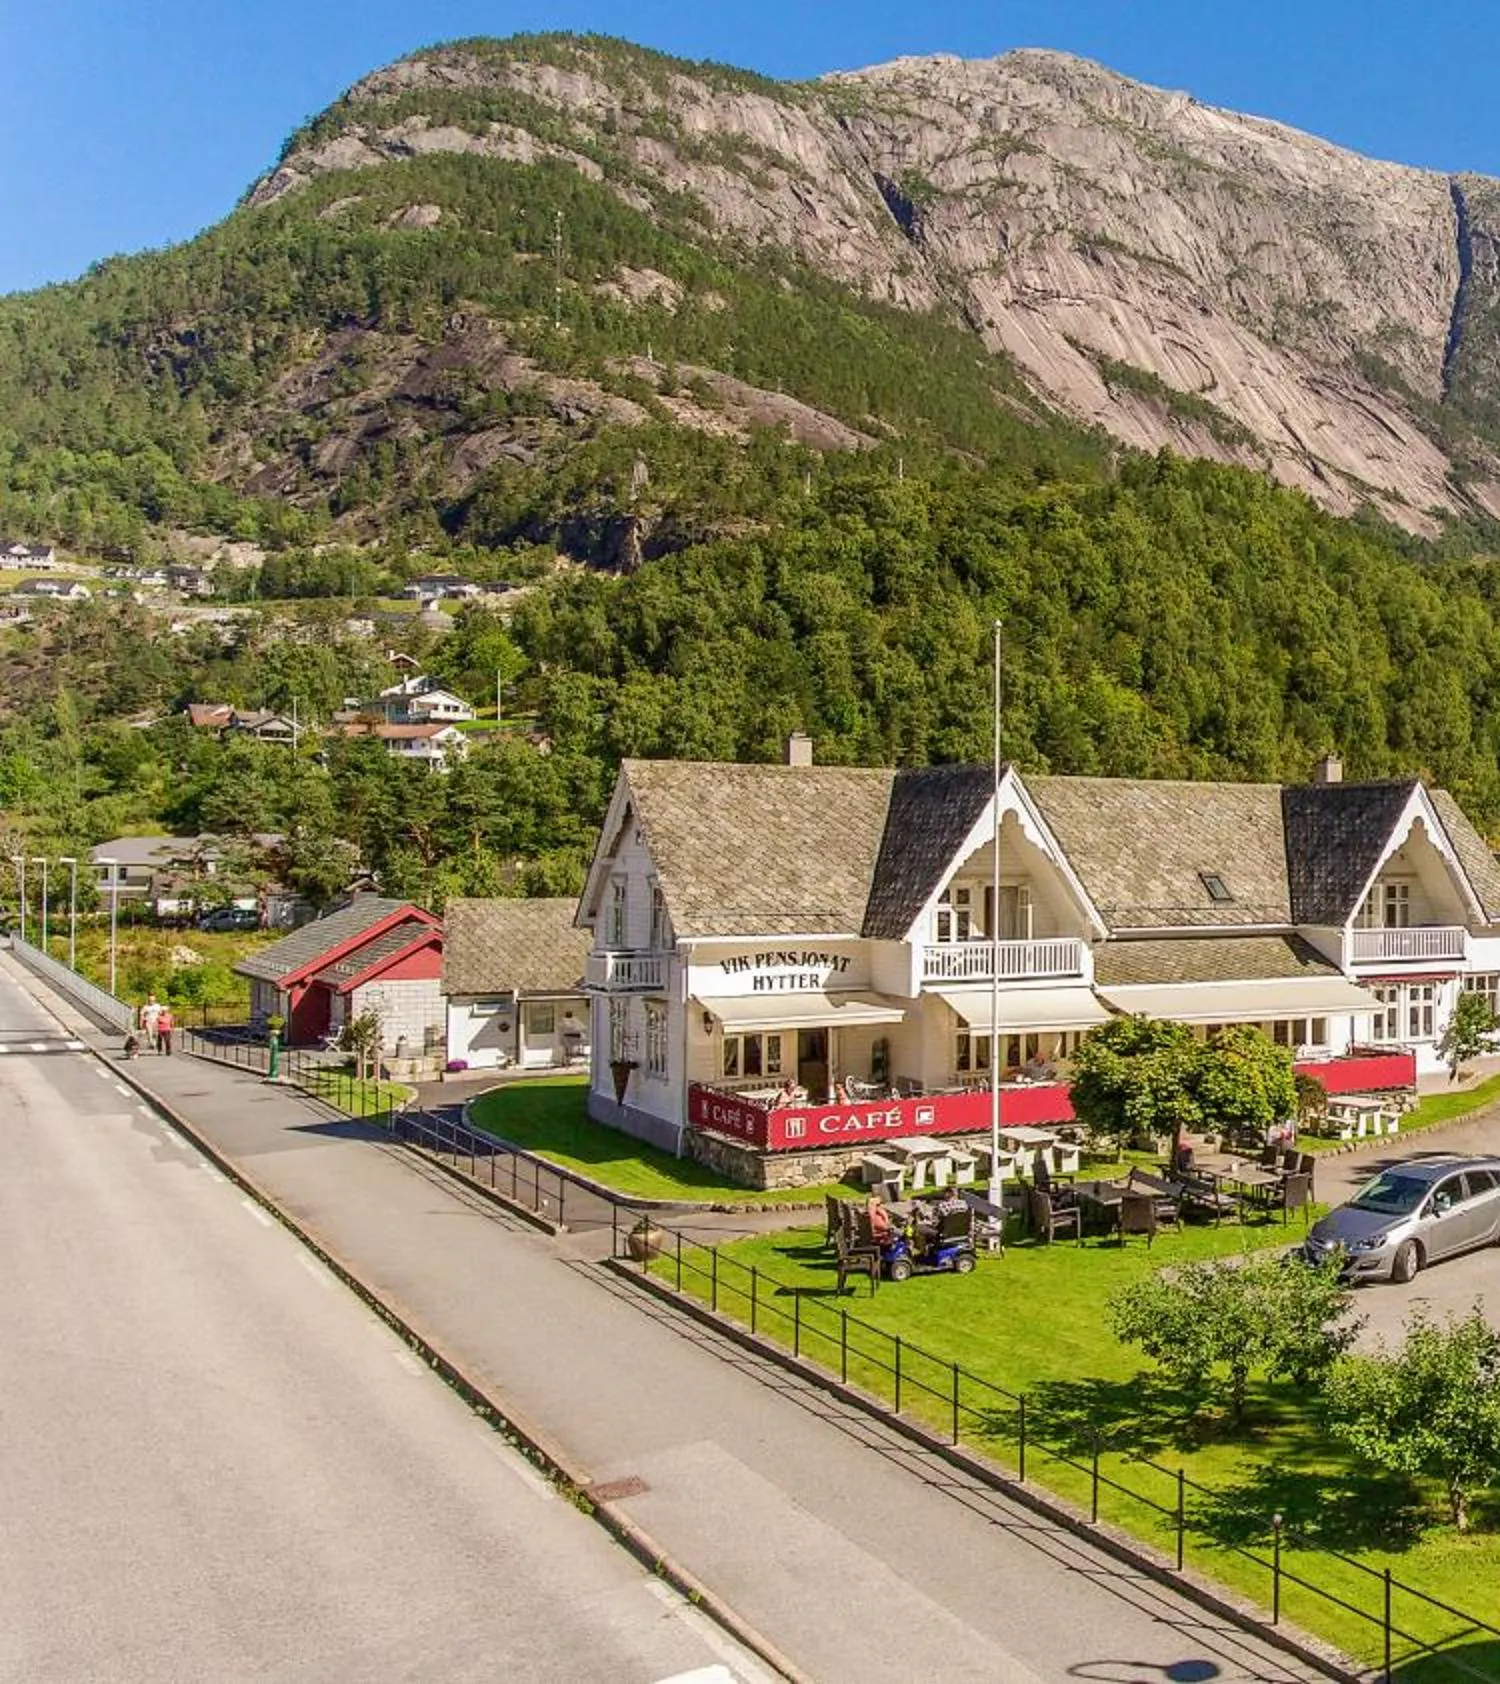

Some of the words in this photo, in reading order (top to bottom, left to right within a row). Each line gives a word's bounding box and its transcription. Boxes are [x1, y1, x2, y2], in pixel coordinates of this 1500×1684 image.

[719, 957, 750, 975] VIK
[755, 950, 851, 974] PENSJONAT
[752, 973, 820, 991] HYTTER
[712, 1105, 742, 1130] CAFÉ
[818, 1107, 903, 1133] CAFÉ
